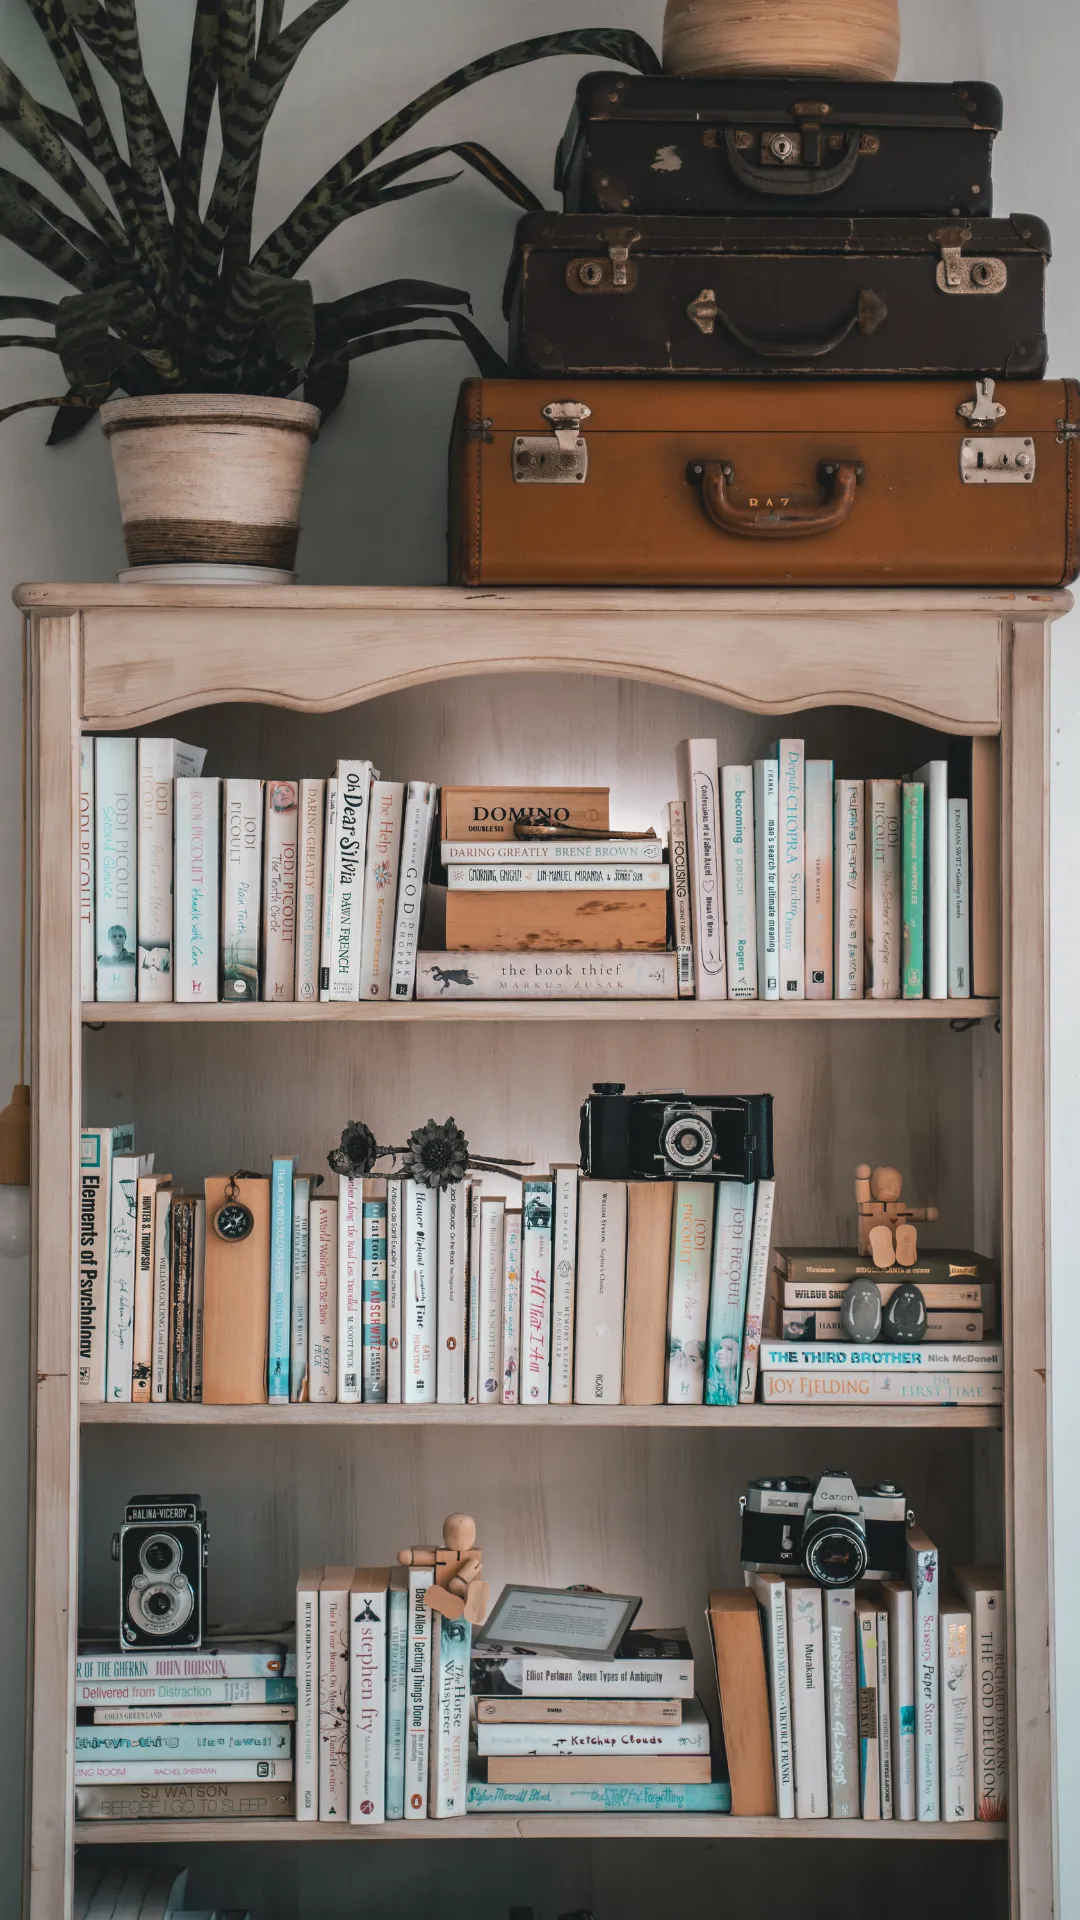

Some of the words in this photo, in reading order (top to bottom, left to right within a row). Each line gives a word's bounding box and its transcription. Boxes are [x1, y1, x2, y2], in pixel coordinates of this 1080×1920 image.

[142, 766, 153, 830] PICOULT
[348, 774, 360, 792] Oh
[115, 793, 128, 830] JODI
[155, 782, 167, 816] JODI
[307, 789, 317, 834] DARING
[341, 794, 362, 835] Dear
[473, 807, 570, 822] DOMINO
[103, 806, 115, 851] Second
[244, 816, 256, 849] JODI
[733, 791, 745, 843] becoming
[768, 820, 776, 842] man's
[876, 803, 884, 862] PICOULT
[887, 816, 898, 848] JODI
[230, 802, 241, 864] PICOULT
[282, 842, 295, 875] JODI
[305, 837, 316, 888] GREATLY
[340, 837, 360, 884] Silvia
[450, 848, 494, 857] DARING
[498, 848, 549, 857] GREATLY
[555, 846, 592, 856] BRENÉ
[595, 847, 638, 856] BROWN
[768, 845, 776, 870] search
[103, 856, 116, 898] Glance
[116, 840, 129, 914] PICOULT
[675, 841, 686, 897] FOCUSING
[734, 859, 745, 895] person
[238, 882, 249, 905] Plain
[341, 893, 352, 925] DAWN
[769, 886, 777, 916] ultimate
[238, 909, 248, 935] Truth
[282, 882, 293, 944] PICOULT
[304, 893, 316, 932] BRENÉ
[339, 928, 350, 974] FRENCH
[767, 920, 776, 952] meaning
[303, 934, 314, 978] BROWN
[502, 964, 529, 975] the
[535, 964, 572, 975] book
[582, 964, 621, 975] thief
[736, 940, 747, 971] Rogers
[81, 1176, 100, 1246] Elements
[142, 1196, 151, 1222] HUNTER
[416, 1193, 426, 1227] Eleanor
[731, 1208, 744, 1240] JODI
[319, 1216, 330, 1242] World
[681, 1204, 692, 1265] PICOULT
[695, 1219, 706, 1251] JODI
[81, 1250, 98, 1265] of
[141, 1232, 151, 1270] THOMPSON
[317, 1244, 328, 1276] Waiting
[371, 1220, 381, 1278] tattooist
[415, 1231, 425, 1266] Oliphant
[320, 1279, 327, 1290] To
[373, 1281, 379, 1289] OF
[530, 1269, 547, 1297] All
[686, 1272, 697, 1290] The
[728, 1247, 743, 1308] PICOULT
[158, 1292, 166, 1327] GOLDING
[320, 1292, 327, 1302] Be
[684, 1297, 697, 1320] Pact
[795, 1290, 826, 1299] WILBUR
[81, 1269, 97, 1358] Psychology
[319, 1305, 327, 1324] Born
[370, 1291, 381, 1351] AUSCHWITZ
[416, 1305, 425, 1330] Fine
[529, 1301, 545, 1331] That
[157, 1329, 165, 1343] Lord
[530, 1333, 544, 1345] I
[529, 1347, 543, 1373] Am
[769, 1352, 798, 1363] THE
[802, 1352, 846, 1363] THIRD
[851, 1351, 922, 1364] BROTHER
[928, 1354, 950, 1362] Nick
[953, 1354, 997, 1363] McDonell
[769, 1379, 794, 1396] JOY
[800, 1377, 869, 1396] FIELDING
[902, 1386, 939, 1397] FIRST
[950, 1386, 983, 1397] TIME
[933, 1377, 951, 1385] THE
[821, 1492, 853, 1501] Canon
[133, 1508, 187, 1519] HALINA-VICEROY
[415, 1589, 426, 1612] David
[415, 1614, 425, 1634] Allen
[923, 1615, 934, 1661] Scissors
[412, 1642, 425, 1672] Getting
[981, 1632, 993, 1662] THE
[85, 1662, 95, 1677] OF
[98, 1662, 111, 1677] THE
[114, 1661, 148, 1677] GHERKIN
[156, 1661, 181, 1675] JOHN
[184, 1660, 226, 1675] DOBSON
[357, 1628, 377, 1700] stephen
[454, 1665, 464, 1684] The
[526, 1669, 543, 1681] Elliot
[546, 1670, 572, 1681] Perlman
[578, 1670, 597, 1681] Seven
[599, 1670, 618, 1682] Types
[621, 1670, 627, 1681] of
[630, 1671, 662, 1683] Ambiguity
[805, 1644, 815, 1689] Murakami
[83, 1687, 128, 1699] Delivered
[132, 1687, 155, 1697] from
[159, 1686, 211, 1697] Distraction
[411, 1675, 425, 1702] Things
[441, 1659, 455, 1735] Whisperer
[922, 1665, 934, 1699] Paper
[982, 1671, 994, 1708] GOD
[357, 1708, 378, 1733] fry
[413, 1705, 424, 1726] Done
[453, 1685, 466, 1727] Horse
[861, 1688, 870, 1737] DAMAGE
[924, 1703, 935, 1735] Stone
[571, 1736, 616, 1746] Ketchup
[621, 1736, 662, 1745] Clouds
[97, 1768, 126, 1776] ROOM
[183, 1767, 217, 1775] SHERMAN
[925, 1743, 933, 1777] Elizabeth
[982, 1716, 995, 1798] DELUSION
[141, 1787, 158, 1799] SJ
[165, 1786, 227, 1797] WATSON
[923, 1780, 933, 1794] Day
[102, 1801, 161, 1814] BEFORE
[171, 1800, 195, 1813] GO
[200, 1800, 217, 1812] TO
[222, 1798, 267, 1812] SLEEP
